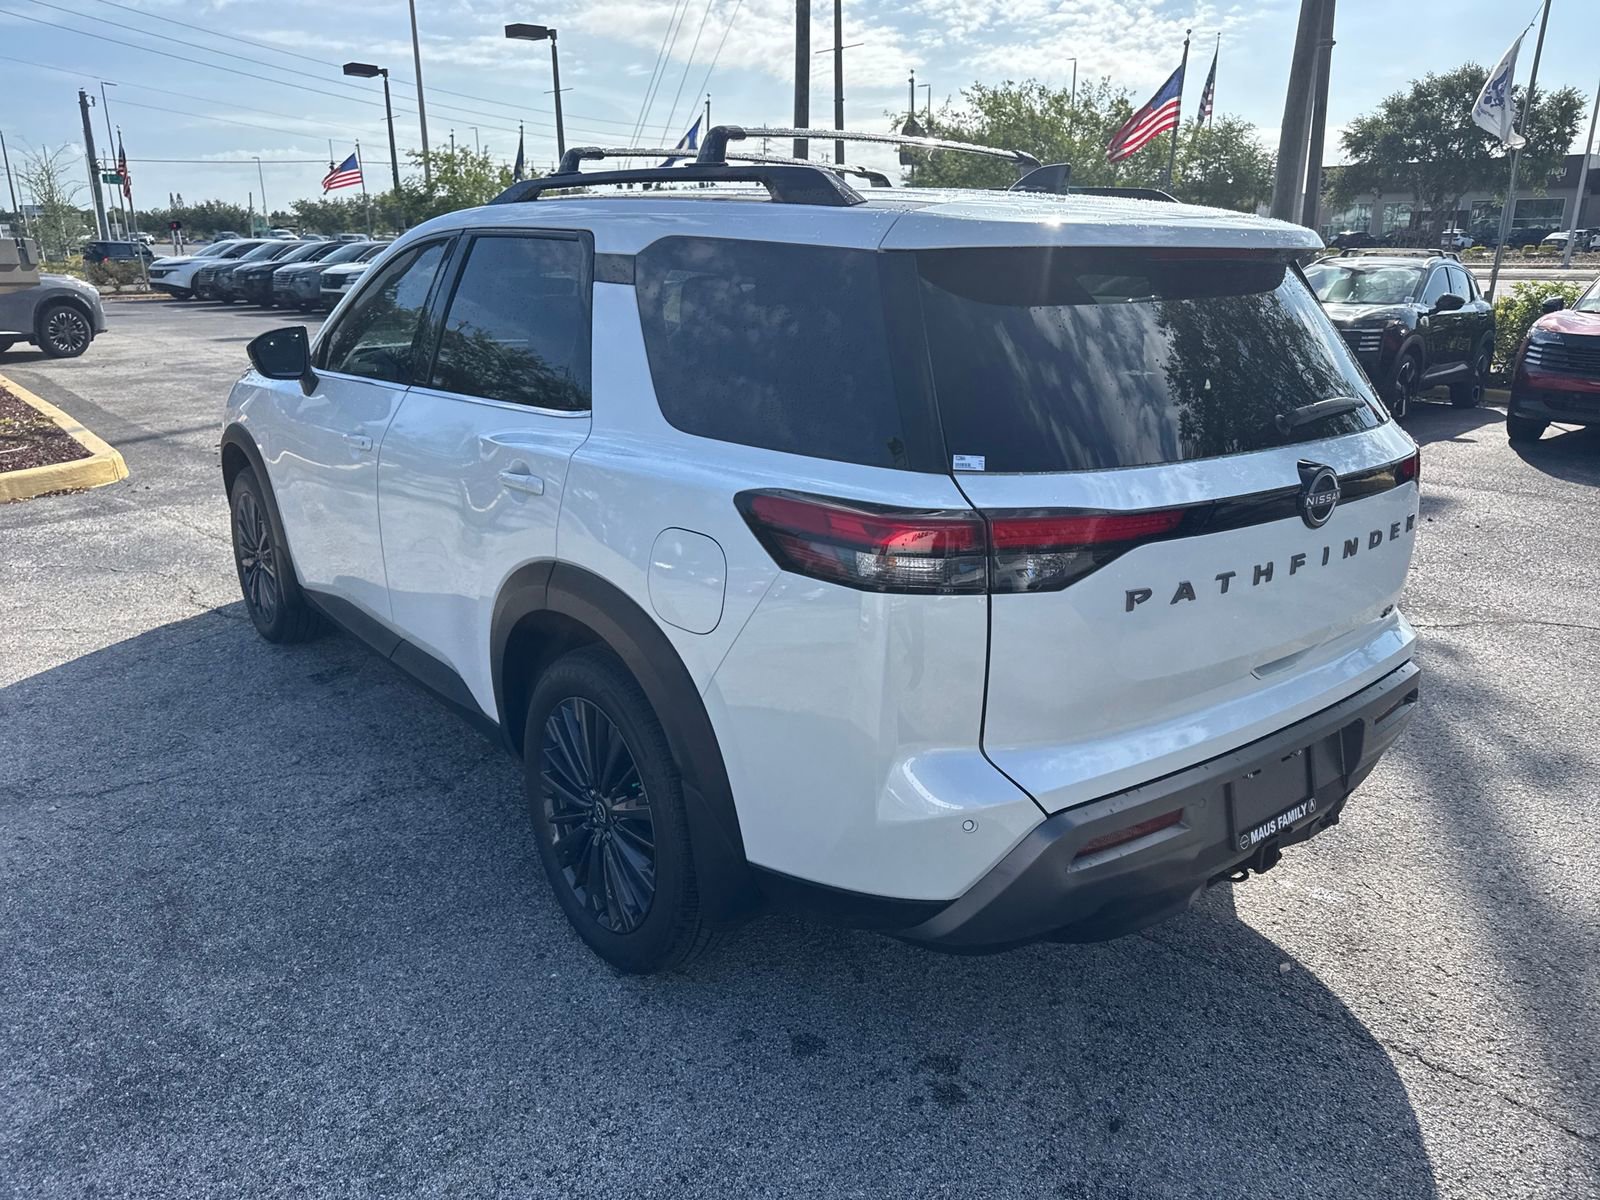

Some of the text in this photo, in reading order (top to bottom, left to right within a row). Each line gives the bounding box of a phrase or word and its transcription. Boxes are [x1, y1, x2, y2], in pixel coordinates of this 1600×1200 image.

[1305, 491, 1340, 506] NISSAN
[1125, 512, 1415, 612] PATHFINDER
[1250, 802, 1307, 845] MAUS FAMILY
